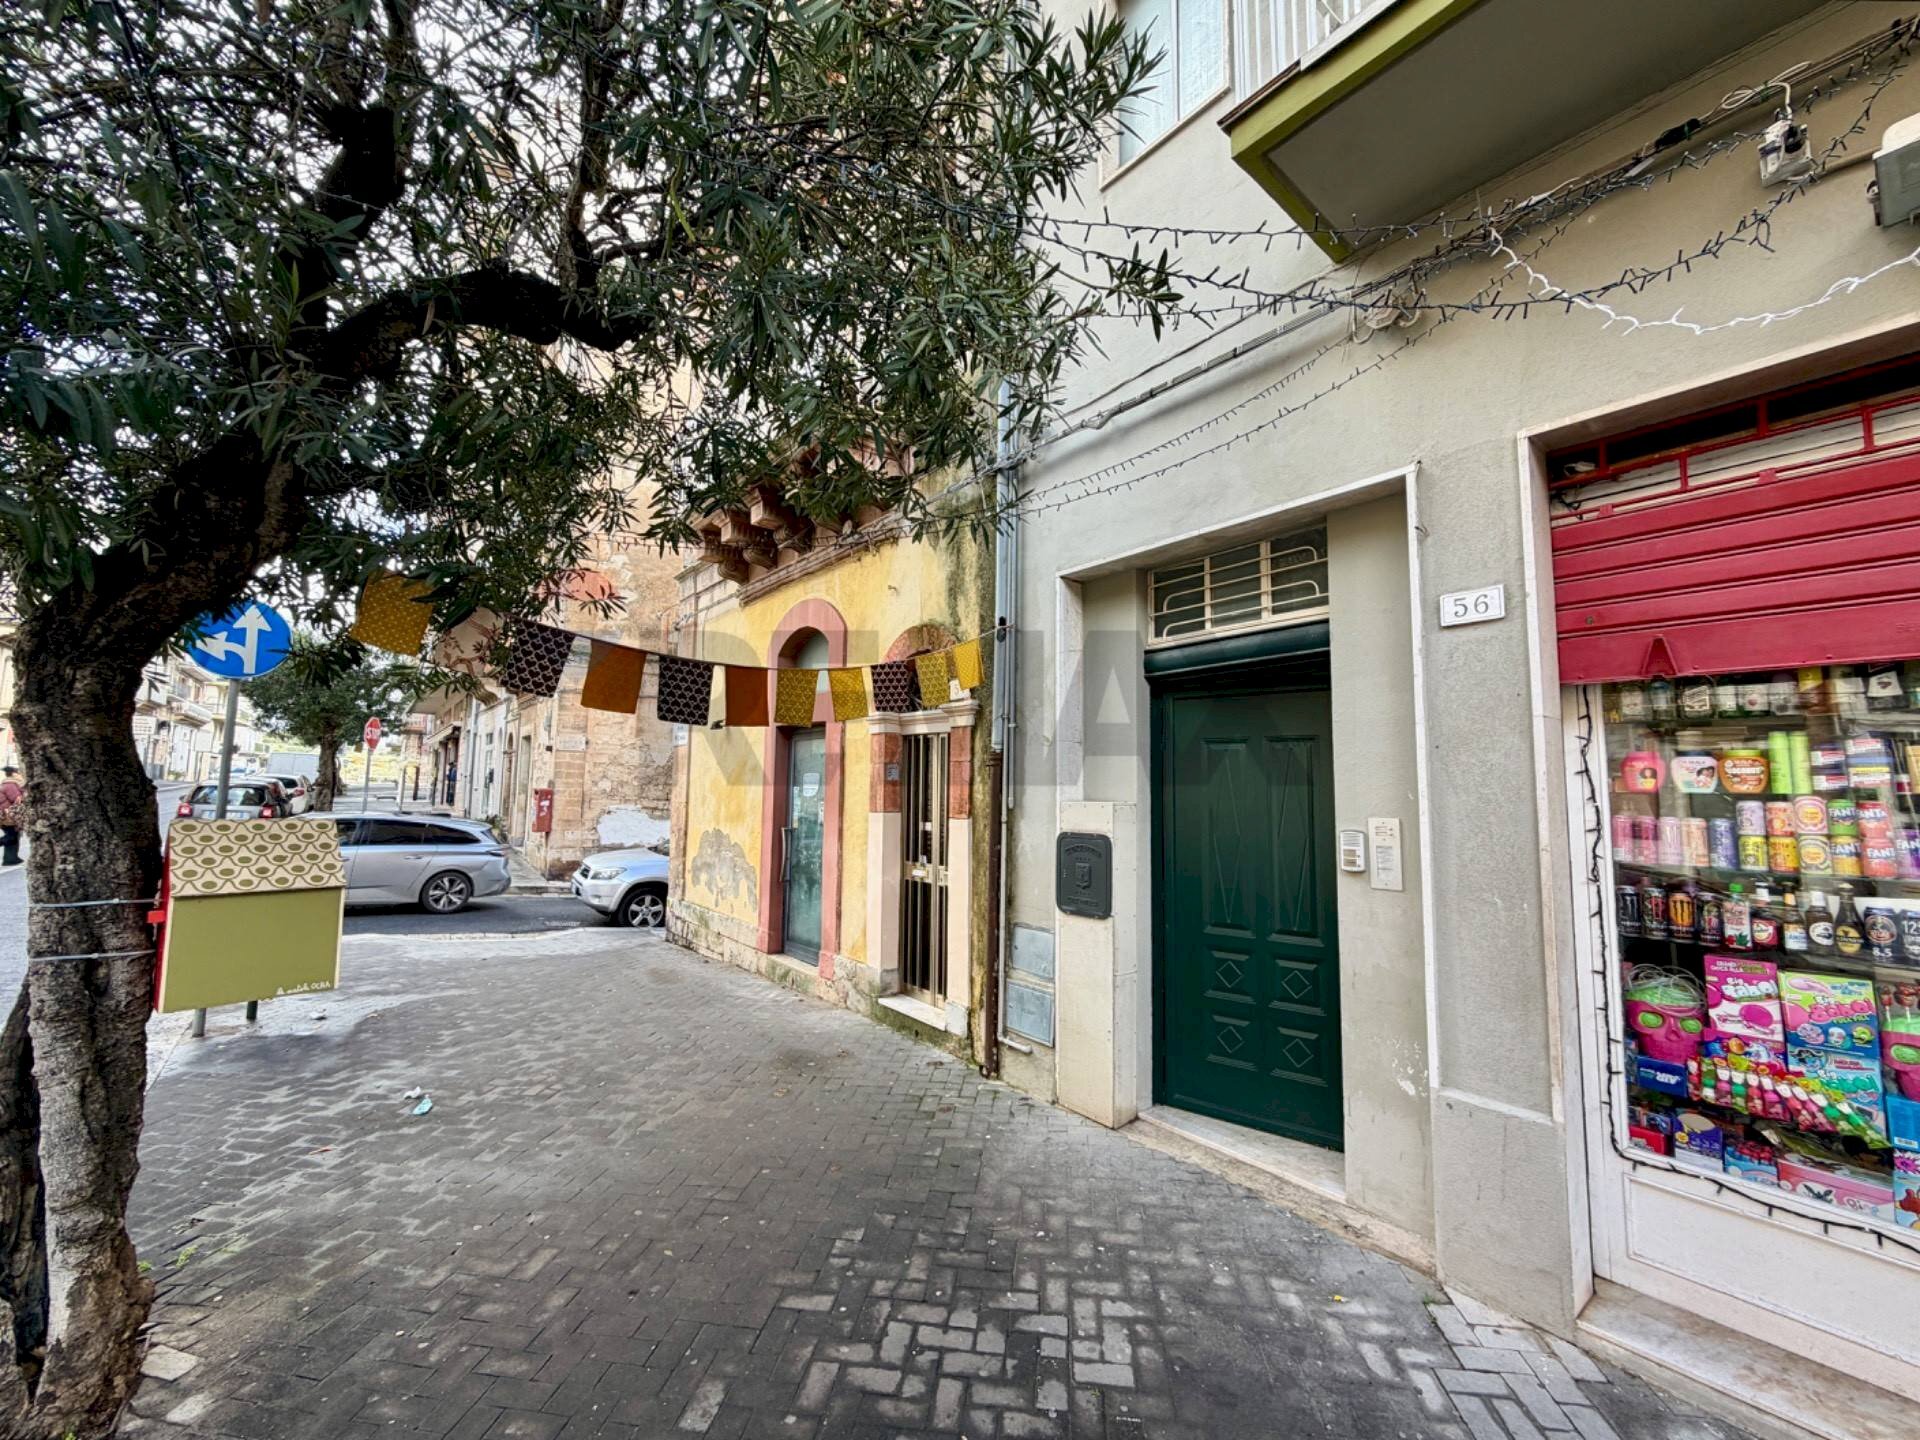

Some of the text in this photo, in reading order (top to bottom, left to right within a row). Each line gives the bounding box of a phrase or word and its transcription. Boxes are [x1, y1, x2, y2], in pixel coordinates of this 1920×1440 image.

[1453, 593, 1490, 618] 56
[366, 727, 382, 740] STOP
[1828, 807, 1857, 818] FANT
[1830, 843, 1861, 855] FANT
[1866, 847, 1896, 857] FANT
